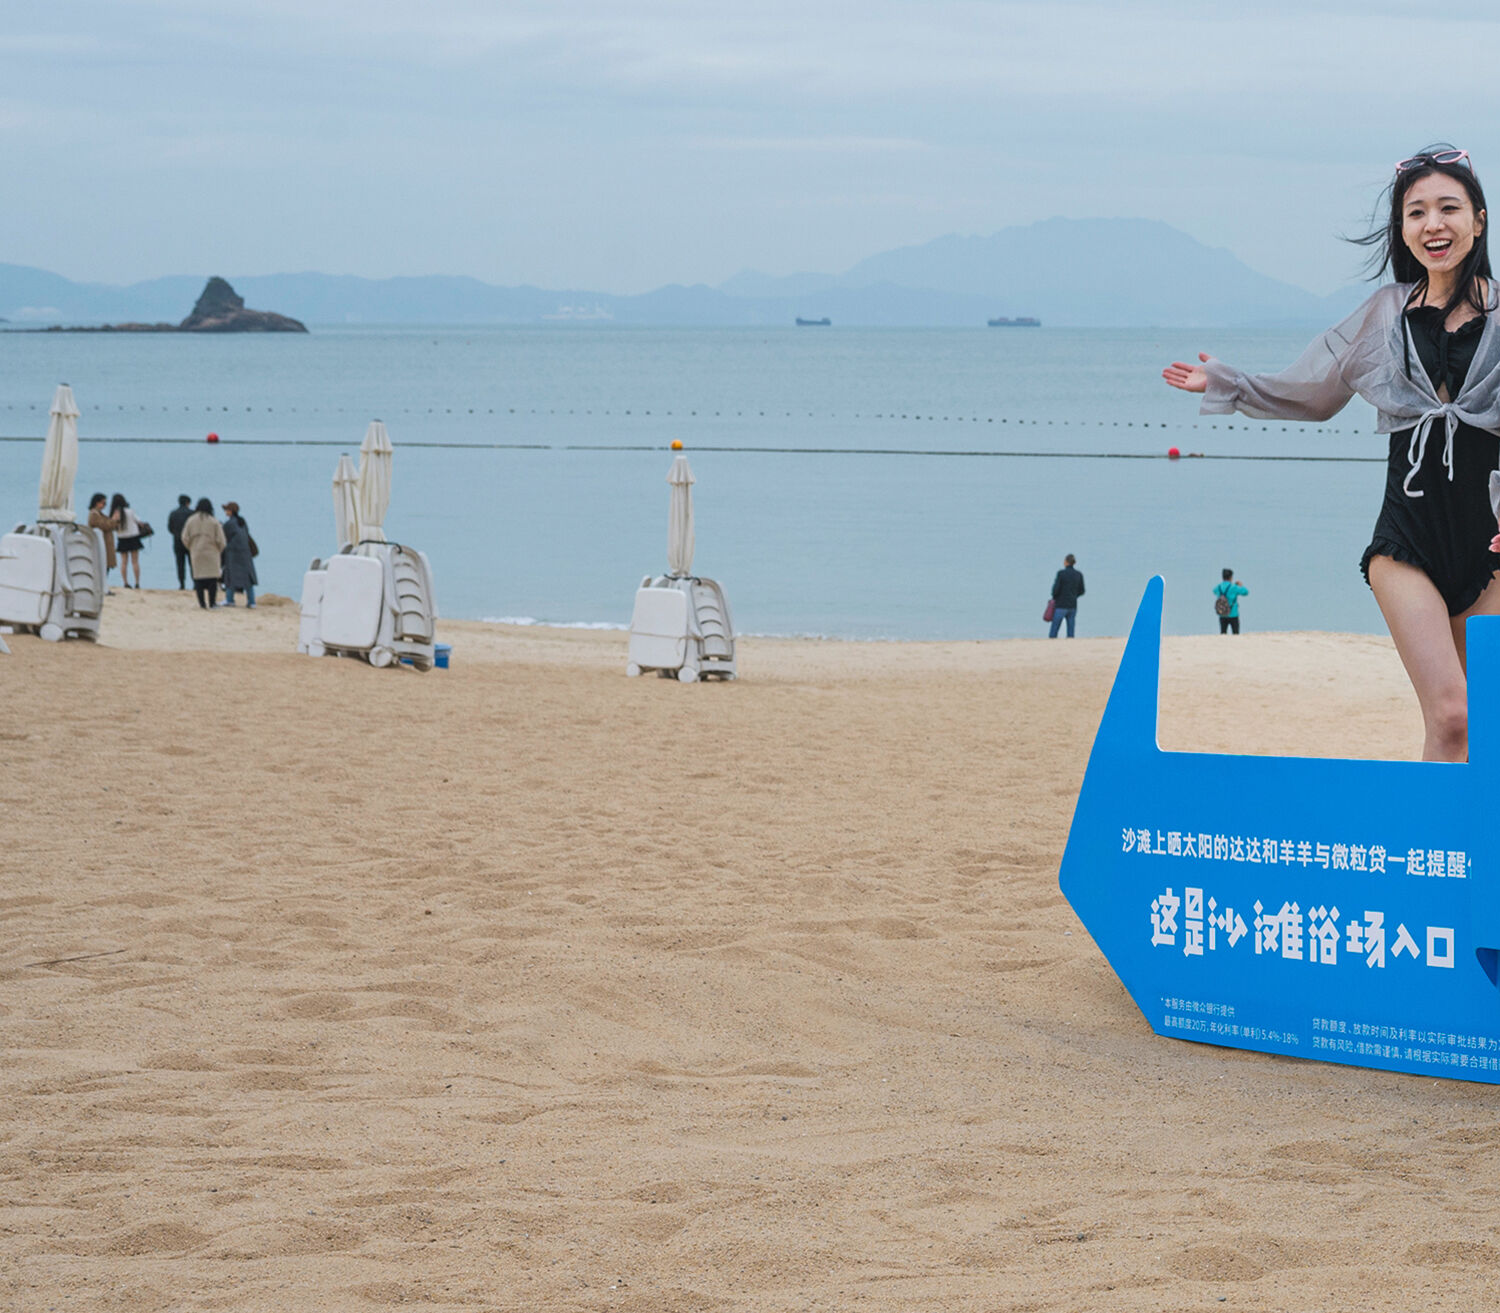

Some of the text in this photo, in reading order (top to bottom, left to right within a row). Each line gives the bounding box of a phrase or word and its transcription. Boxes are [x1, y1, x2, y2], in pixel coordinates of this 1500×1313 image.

[1122, 827, 1472, 879] 沙滩上晒太阳的达达和羊羊与微粒贷一起提醒
[1150, 886, 1455, 969] 这是沙滩浴场入口
